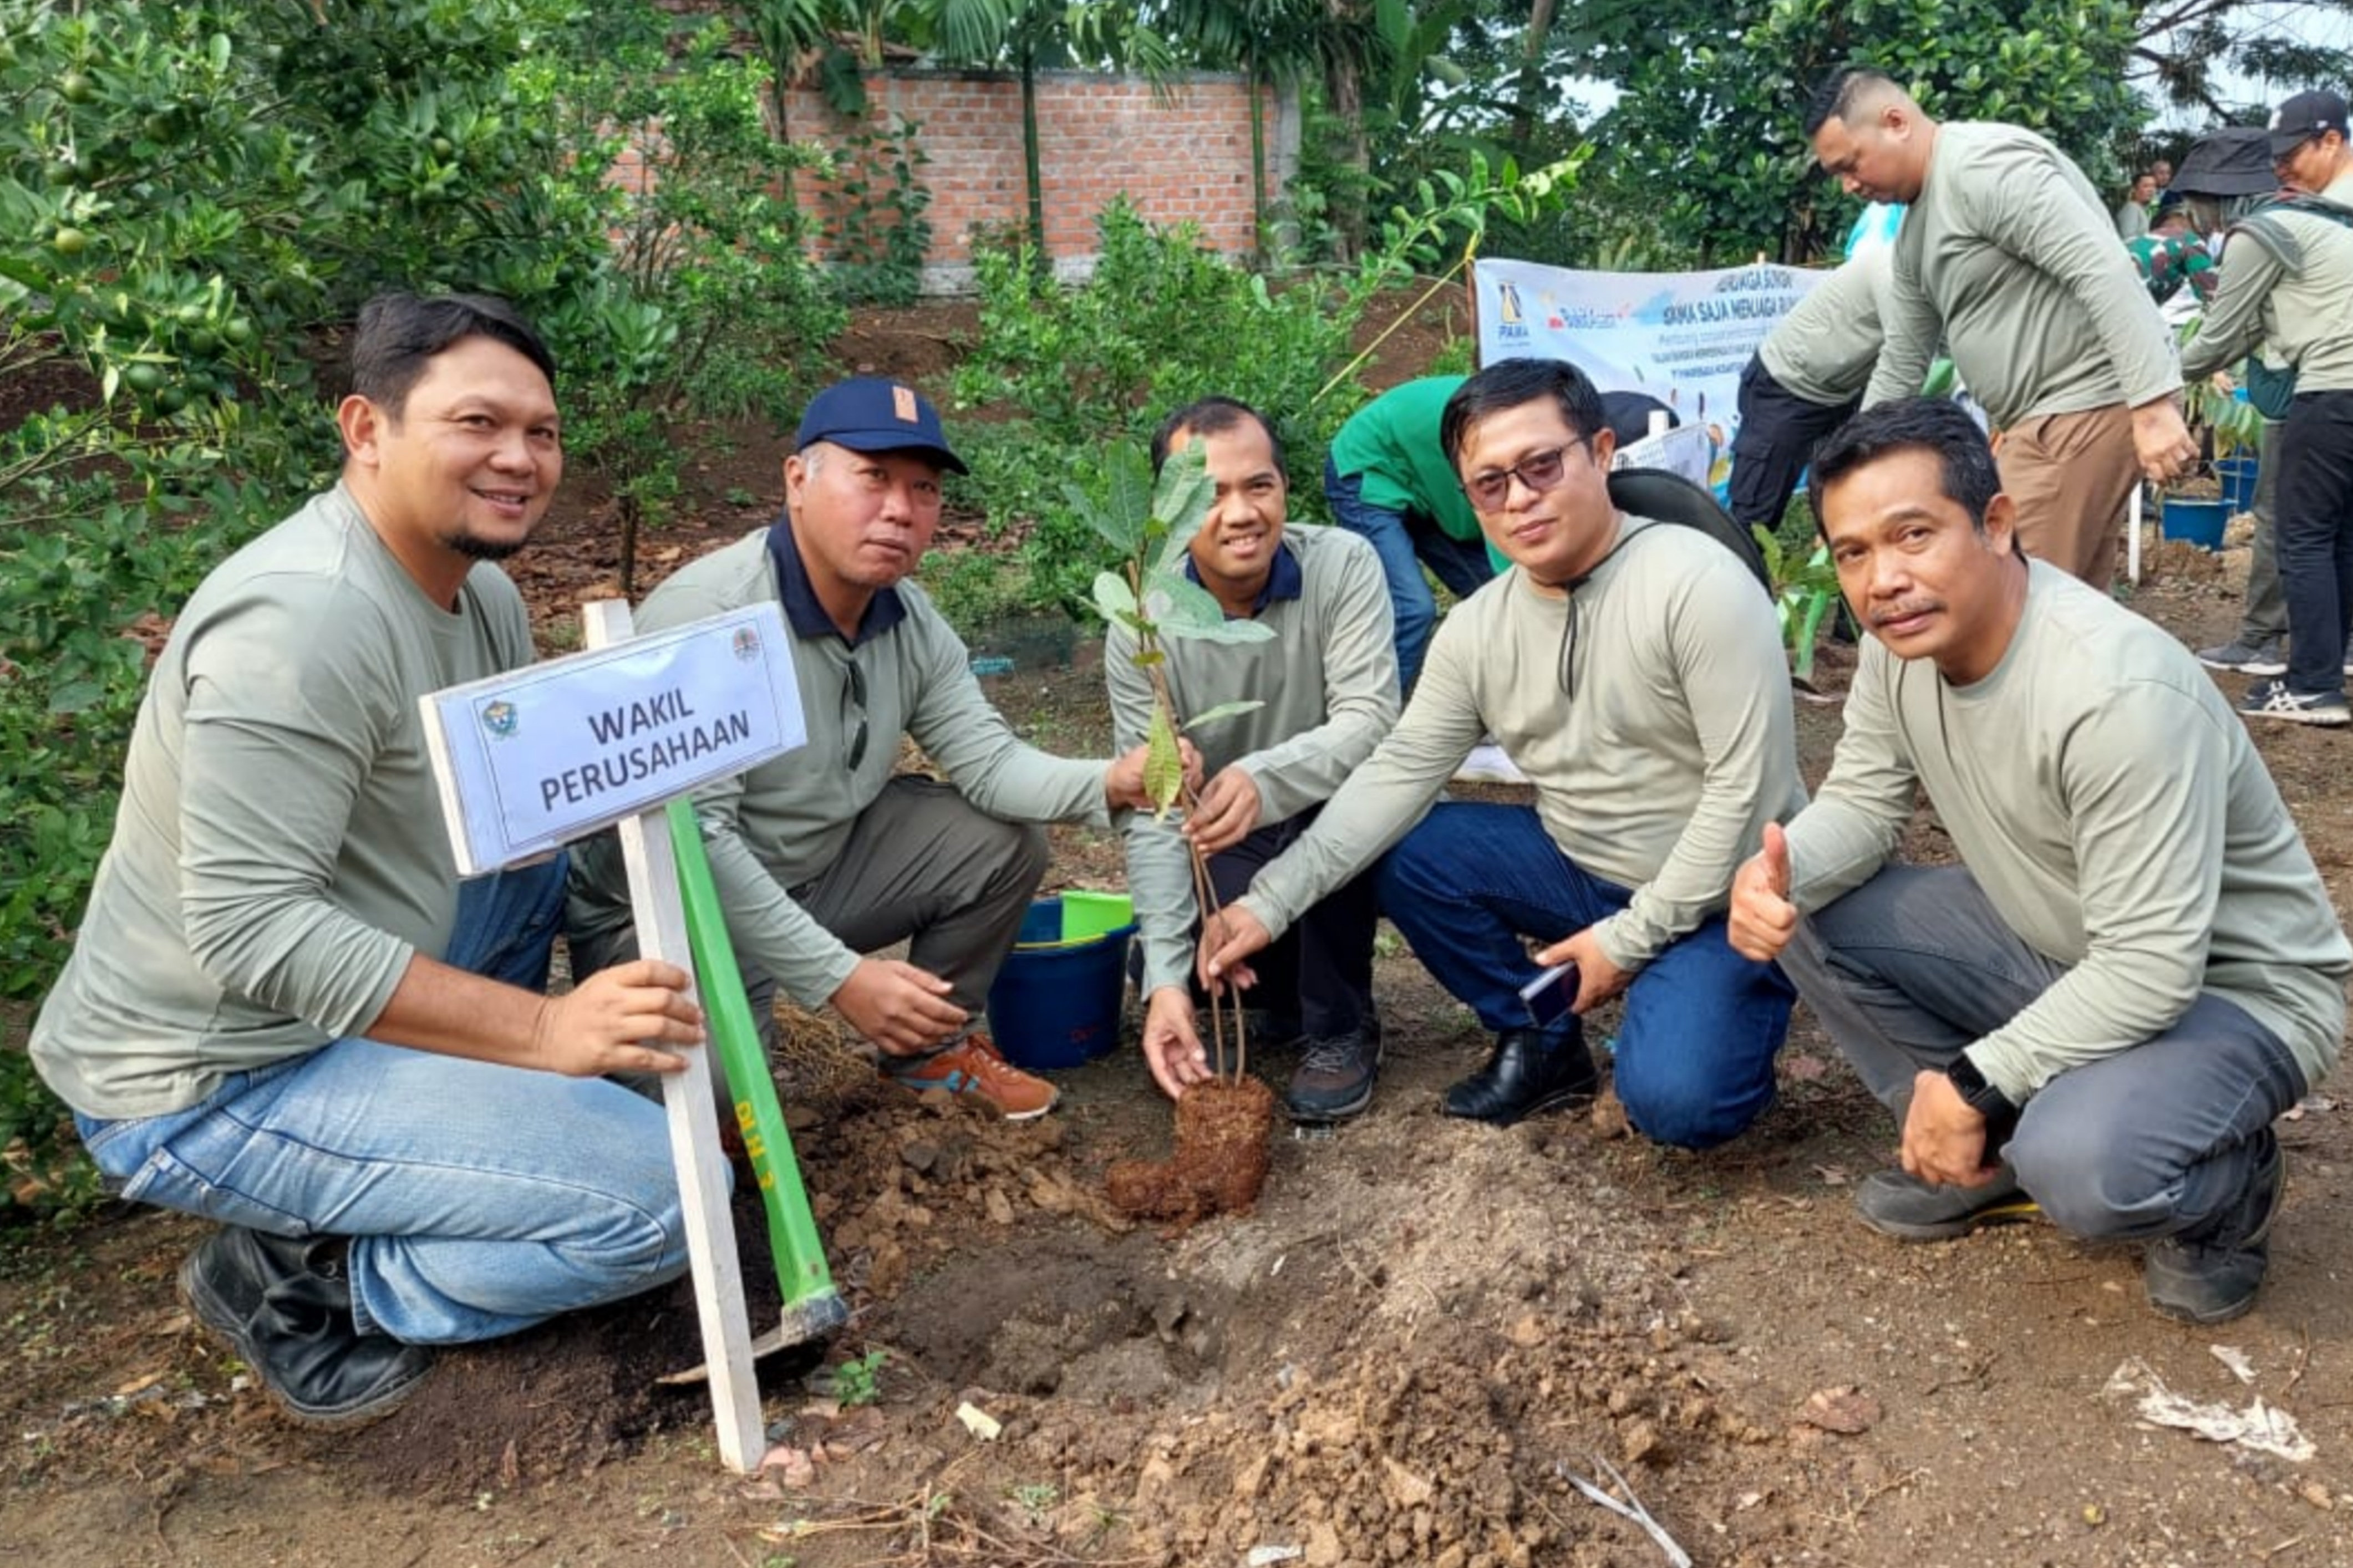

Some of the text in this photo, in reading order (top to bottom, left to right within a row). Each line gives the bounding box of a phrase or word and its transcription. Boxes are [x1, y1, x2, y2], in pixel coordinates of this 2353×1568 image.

[1697, 301, 1730, 322] SAJA
[588, 688, 694, 745] WAKIL
[540, 710, 750, 812] PERUSAHAAN
